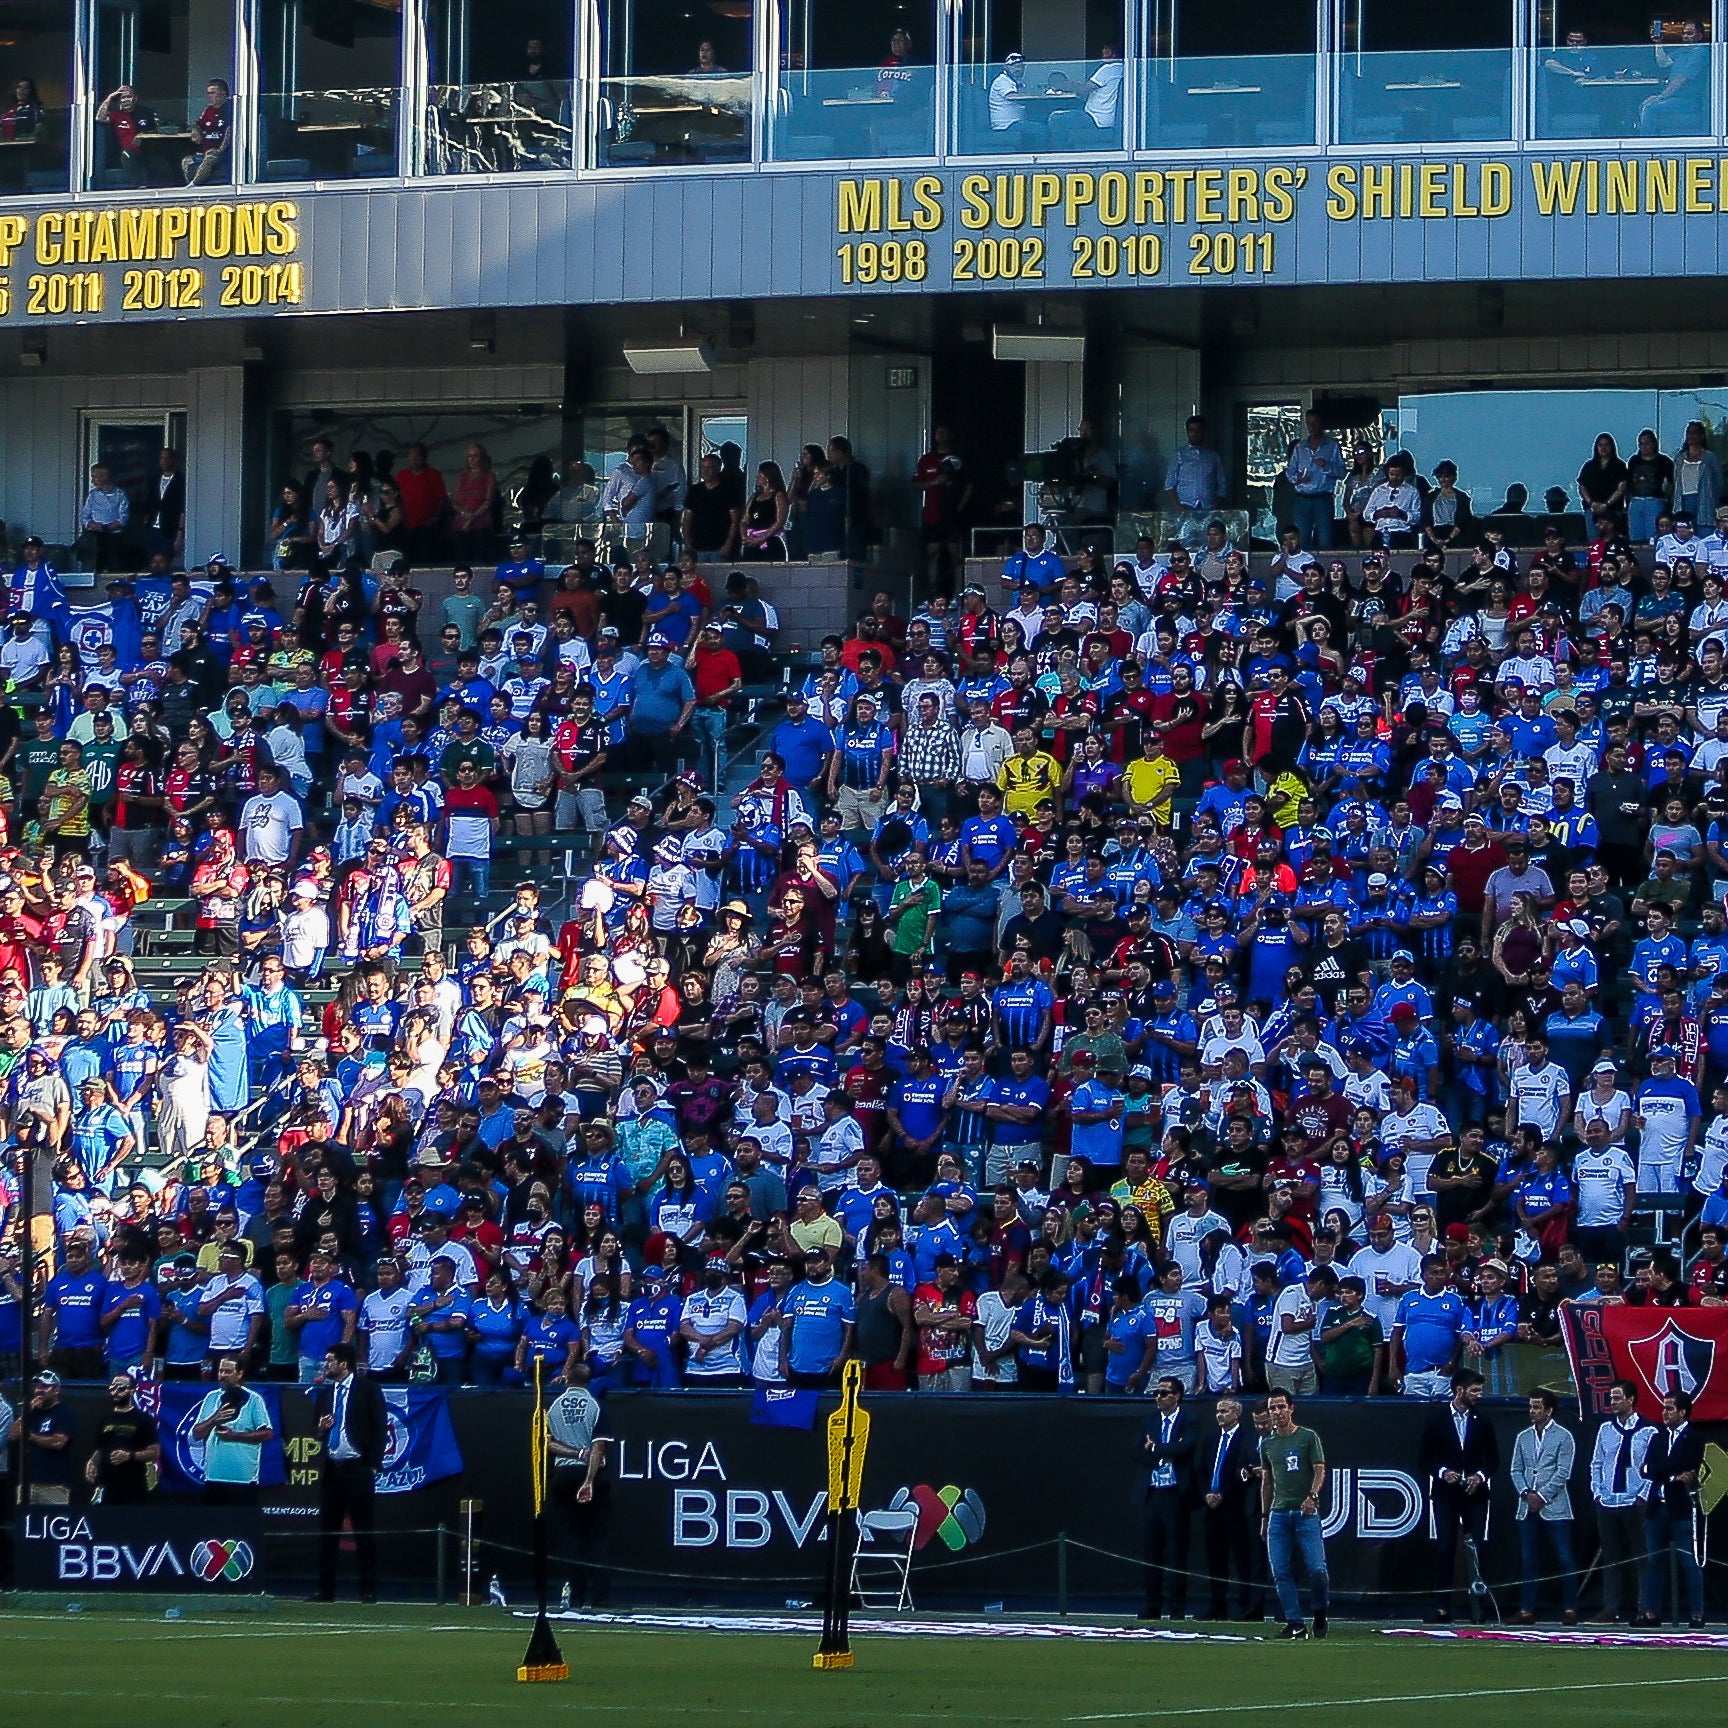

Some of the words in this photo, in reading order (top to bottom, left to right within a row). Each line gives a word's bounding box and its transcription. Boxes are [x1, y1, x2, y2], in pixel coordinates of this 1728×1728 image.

[838, 175, 945, 233] MLS
[1326, 161, 1513, 220] SHIELD
[35, 201, 298, 266] CHAMPIONS
[836, 240, 928, 285] 1998
[953, 237, 1045, 281] 2002
[1072, 233, 1162, 277] 2010
[1188, 231, 1276, 274] 2011
[27, 272, 103, 314] 2011
[122, 267, 203, 310] 2012
[220, 262, 303, 307] 2014
[560, 1397, 587, 1409] CSC
[618, 1440, 726, 1482] LIGA
[24, 1514, 94, 1542] LIGA
[673, 1488, 830, 1549] BBV
[58, 1540, 186, 1581] BBVA
